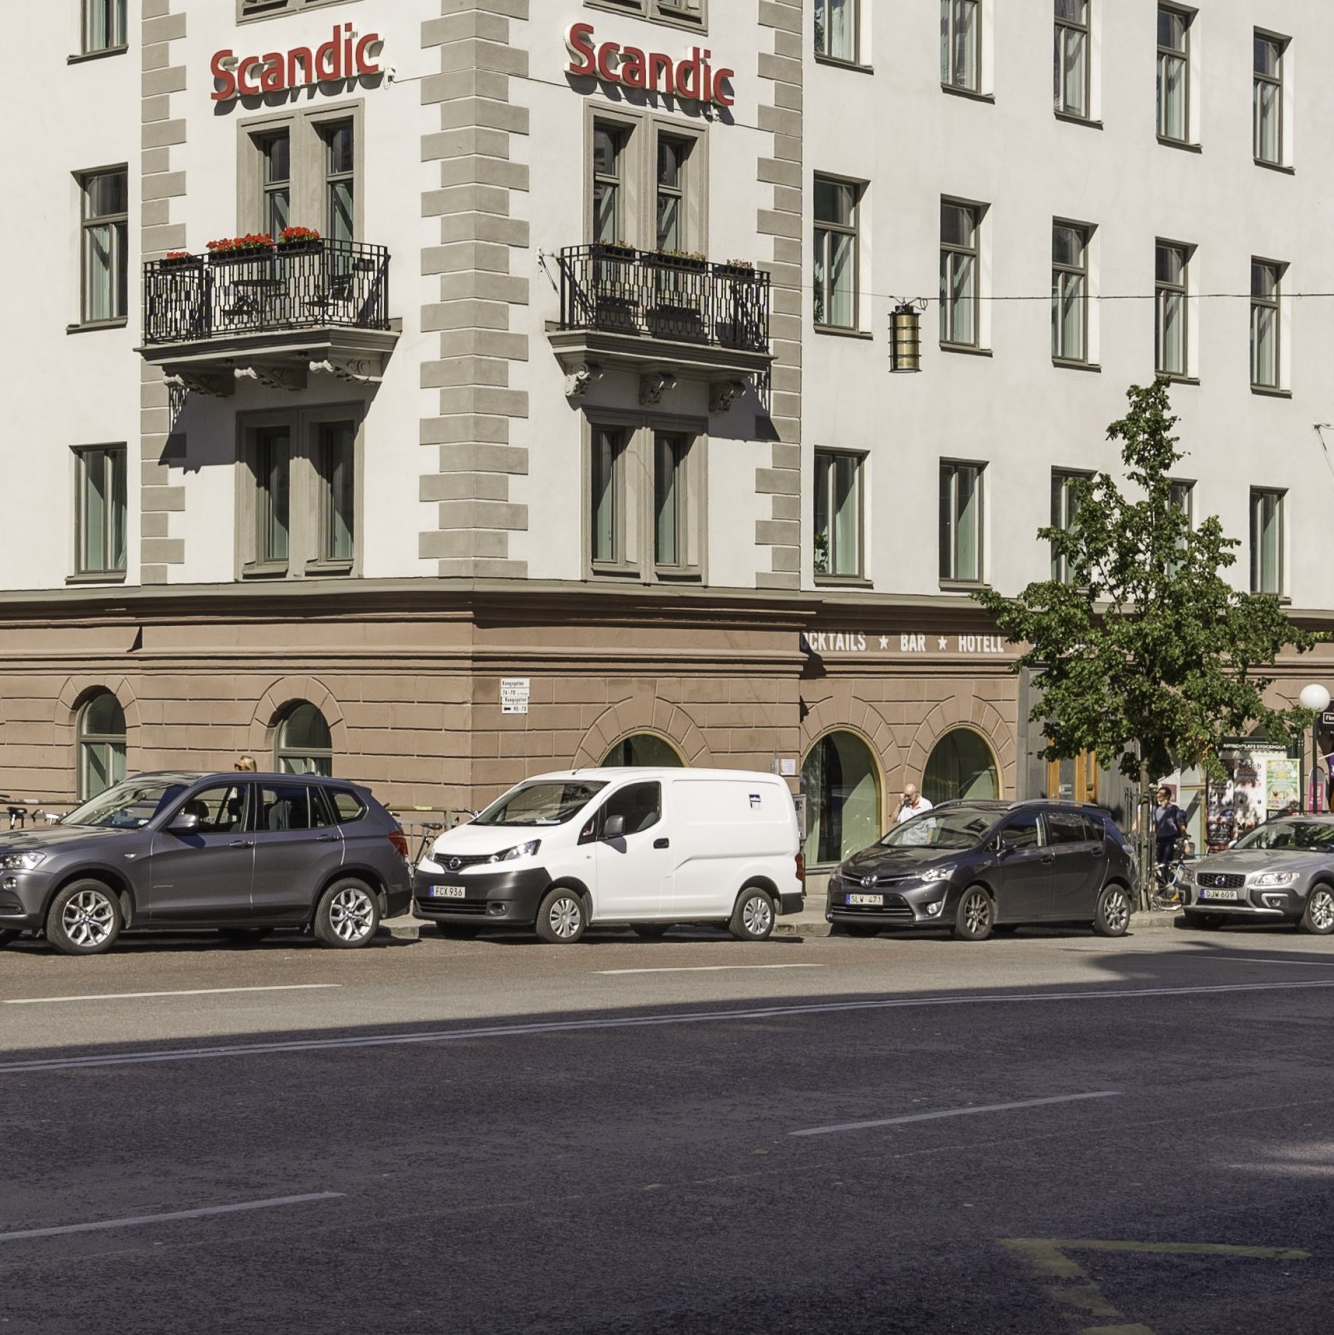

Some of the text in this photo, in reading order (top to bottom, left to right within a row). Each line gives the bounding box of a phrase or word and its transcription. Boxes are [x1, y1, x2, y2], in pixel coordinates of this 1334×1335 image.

[211, 22, 378, 100] Scandic
[569, 22, 734, 106] Scandic
[801, 630, 1004, 653] OCKTAILS BAR HOTELL
[435, 887, 463, 897] FCX 936
